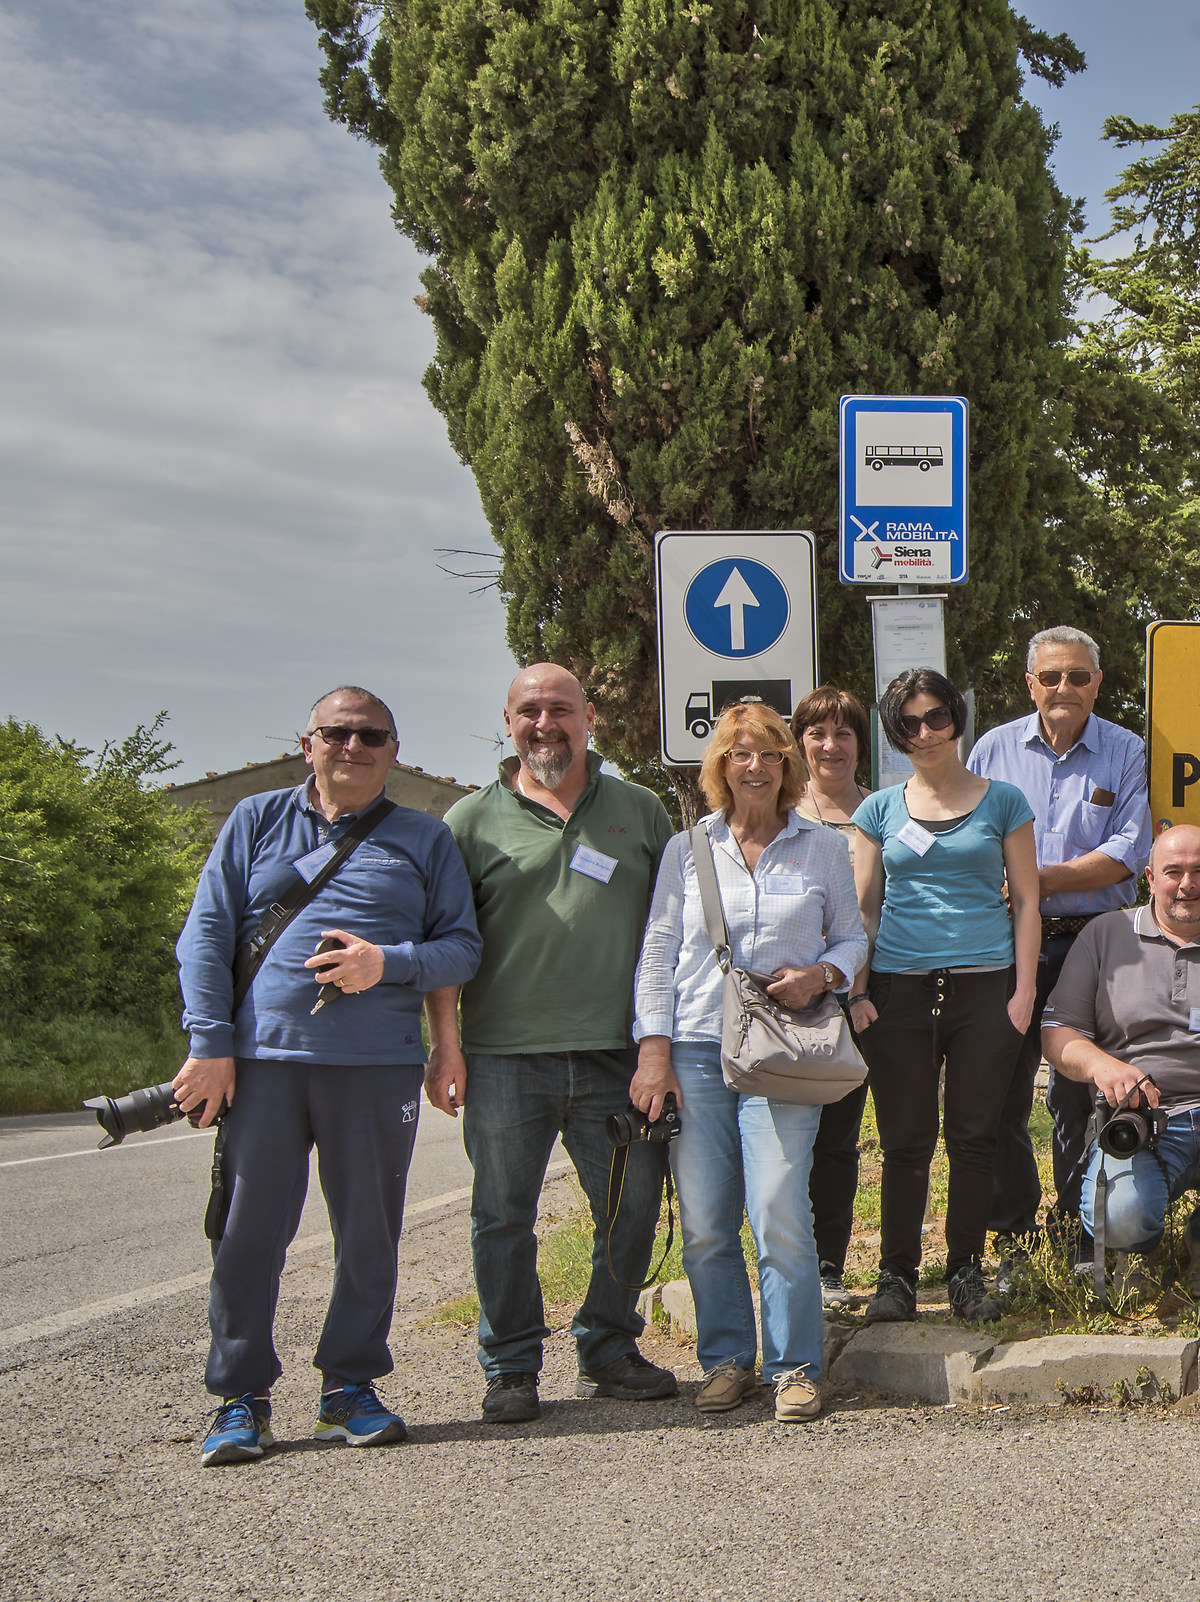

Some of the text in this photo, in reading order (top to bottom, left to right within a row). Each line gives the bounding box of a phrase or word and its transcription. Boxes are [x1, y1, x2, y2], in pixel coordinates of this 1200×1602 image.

[886, 522, 934, 531] RAMA
[886, 530, 959, 540] MOBILITÀ
[894, 546, 931, 557] Siena
